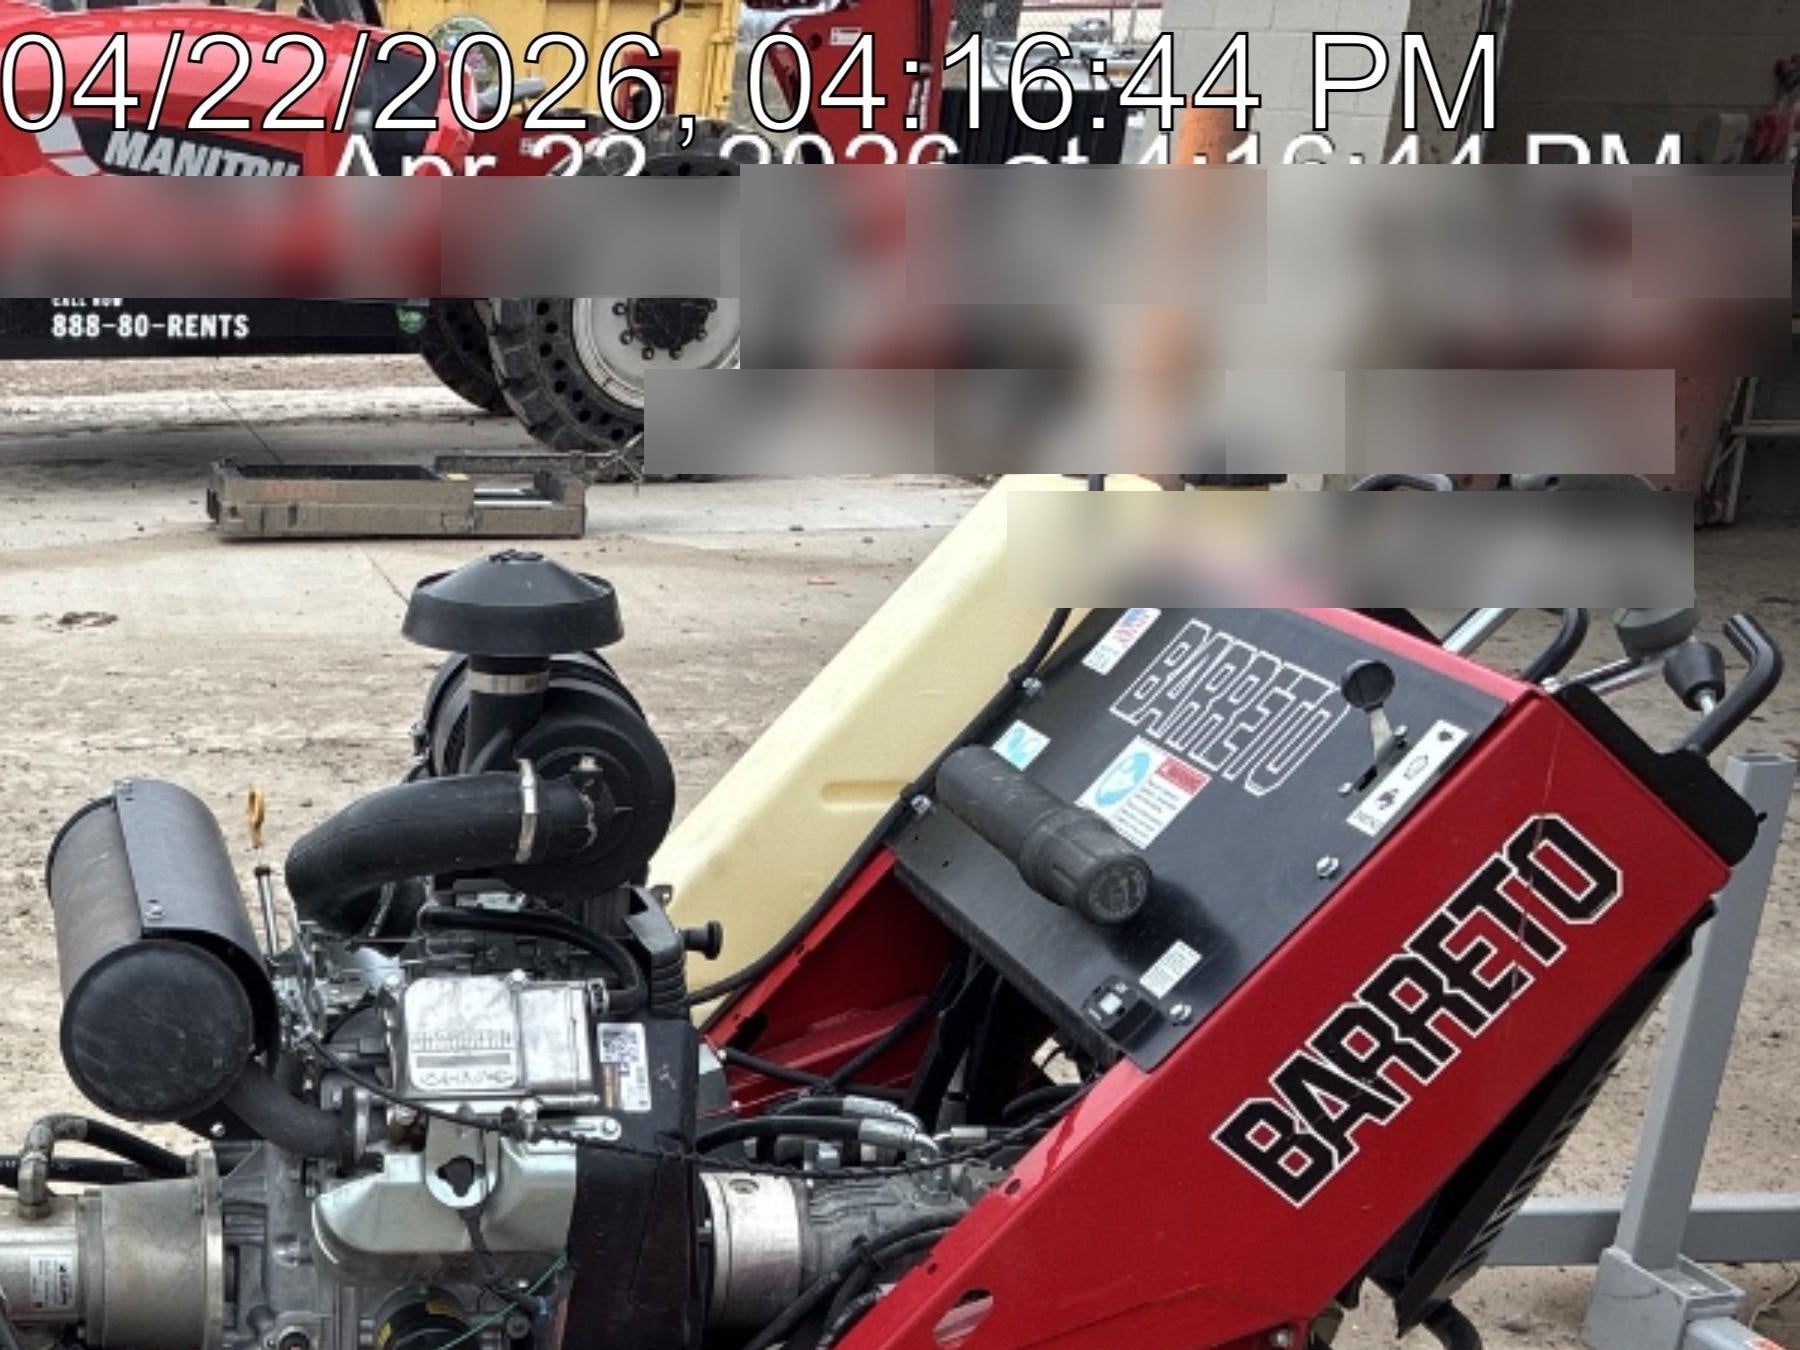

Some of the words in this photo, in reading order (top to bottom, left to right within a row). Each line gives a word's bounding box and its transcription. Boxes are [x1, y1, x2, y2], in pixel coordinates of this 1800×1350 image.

[51, 313, 250, 339] 888-80-RENTS
[1109, 617, 1351, 798] BARRETO
[1210, 813, 1624, 1209] BARRETO
